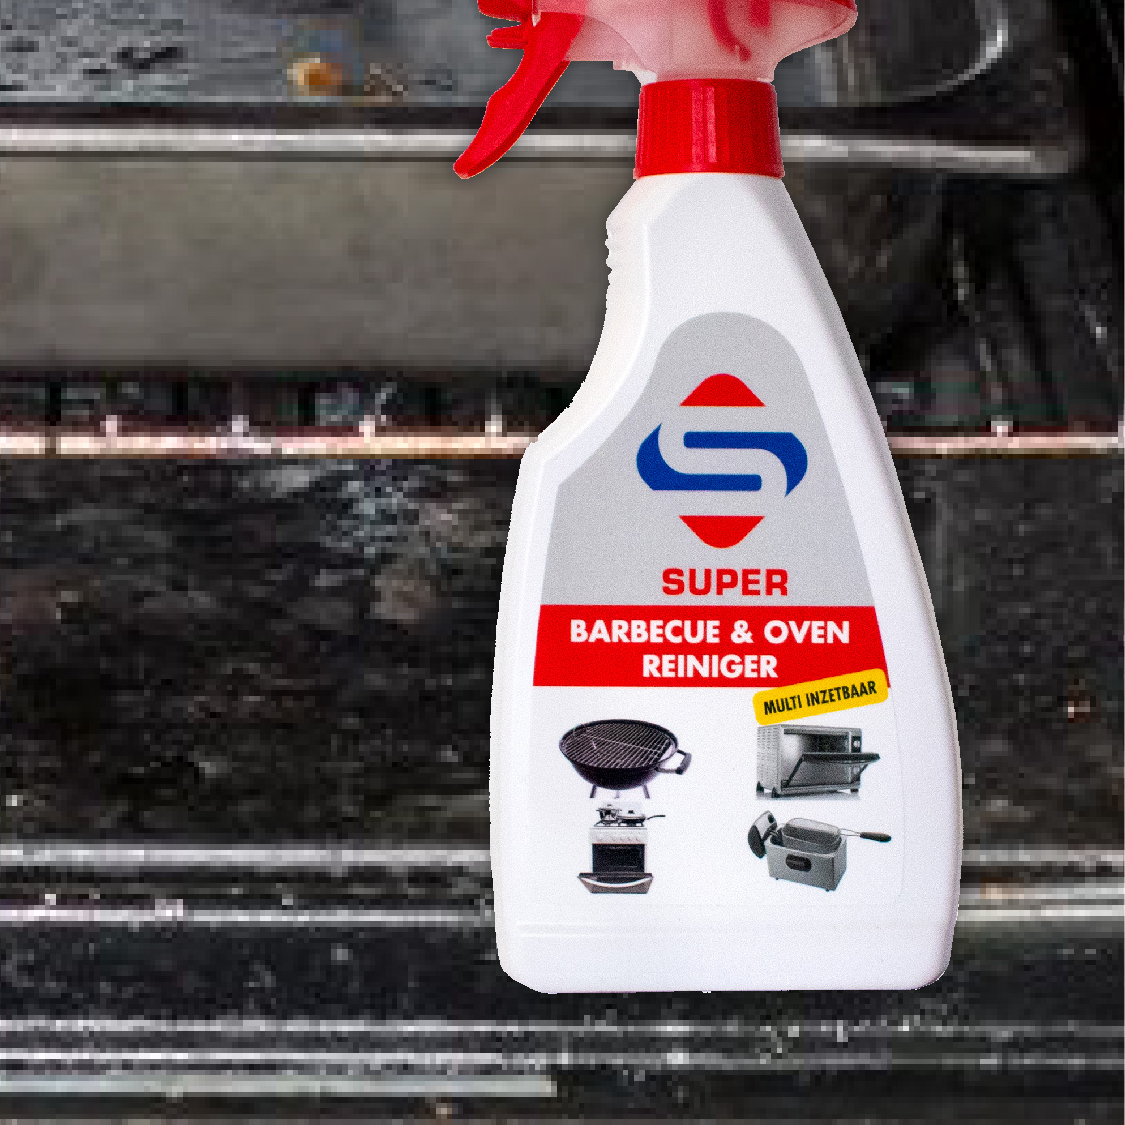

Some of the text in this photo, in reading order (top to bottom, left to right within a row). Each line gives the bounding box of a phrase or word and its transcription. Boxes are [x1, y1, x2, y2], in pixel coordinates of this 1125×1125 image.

[661, 568, 789, 597] SUPER
[569, 619, 851, 645] BARBECUE & OVEN
[642, 654, 779, 679] REINIGER
[763, 679, 878, 717] MULTI INZETBAAR
